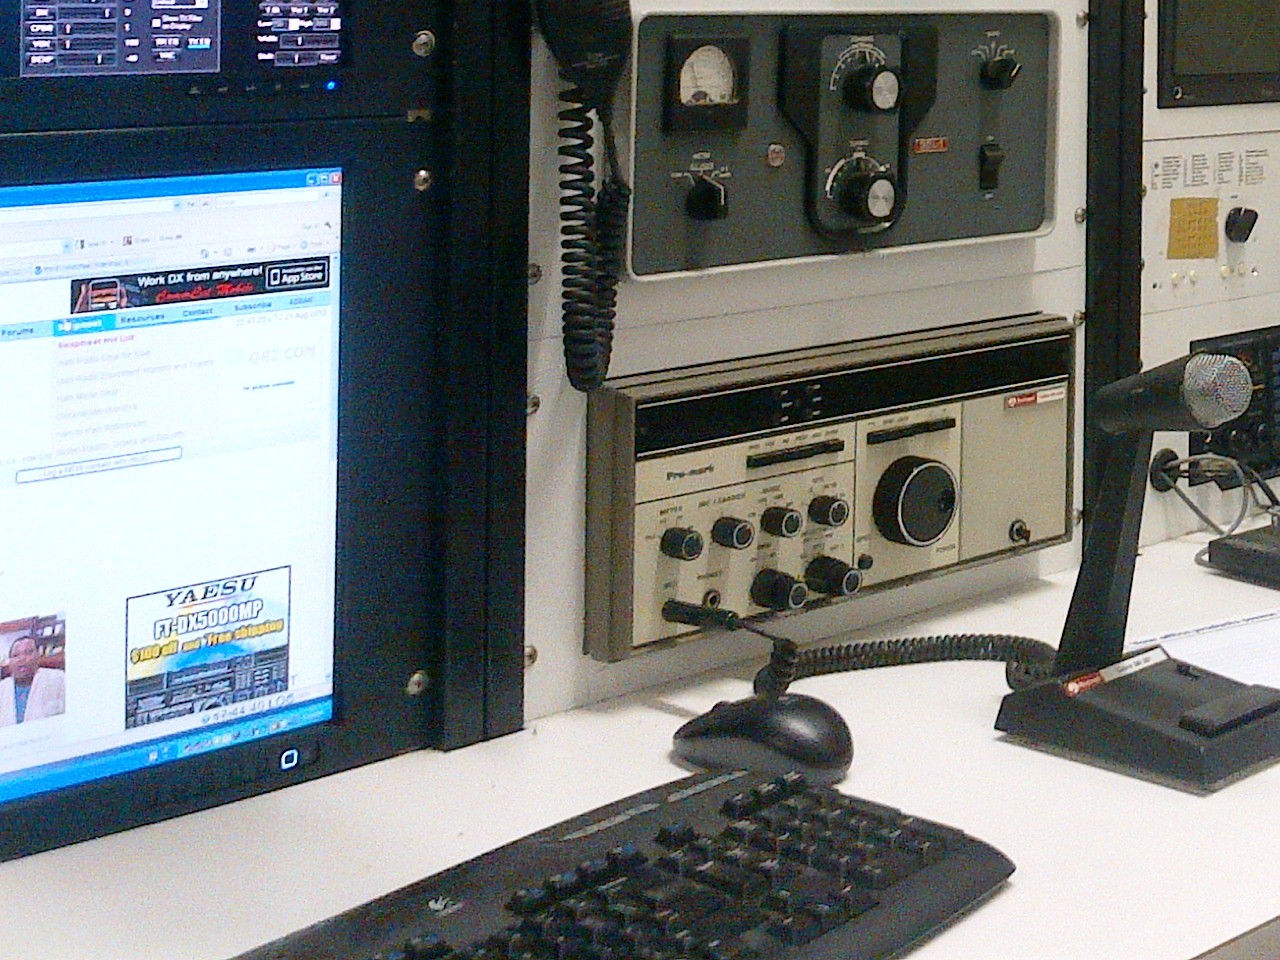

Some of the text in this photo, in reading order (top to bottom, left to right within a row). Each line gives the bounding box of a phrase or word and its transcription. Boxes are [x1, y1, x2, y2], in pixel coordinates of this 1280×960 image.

[137, 273, 166, 288] Work
[167, 271, 185, 284] DX
[186, 268, 210, 282] from
[211, 265, 264, 282] anywhere!
[281, 273, 300, 285] App
[300, 269, 324, 282] Store
[182, 307, 214, 318] Contact
[166, 576, 258, 607] YAESU
[153, 598, 263, 640] FT-DX5000MP
